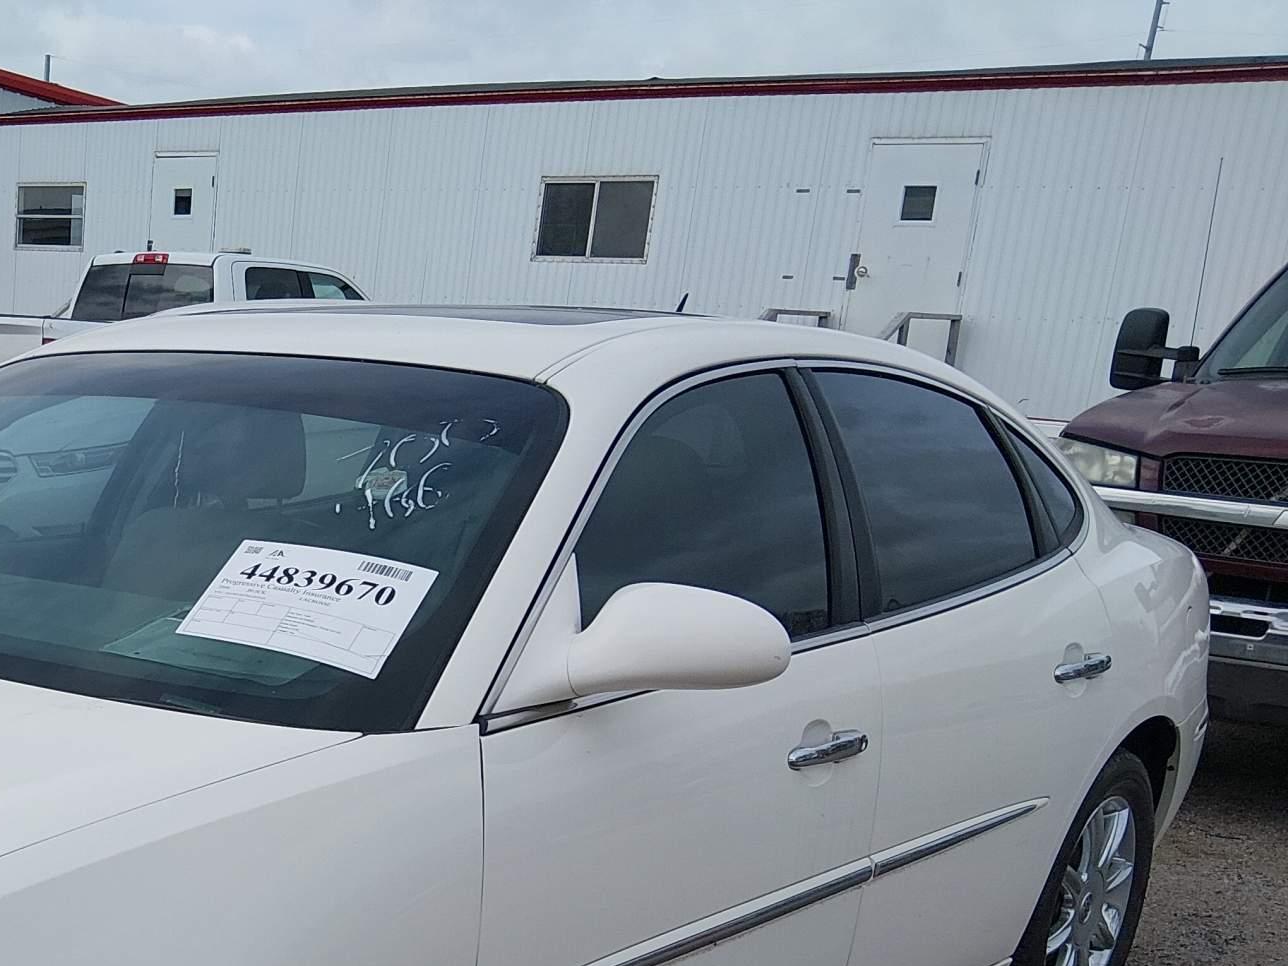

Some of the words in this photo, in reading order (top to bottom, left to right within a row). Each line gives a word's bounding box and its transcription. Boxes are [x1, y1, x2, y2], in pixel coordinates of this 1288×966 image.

[221, 577, 266, 589] Progressive
[266, 583, 301, 595] Casualty
[303, 589, 341, 602] Insurance
[239, 561, 397, 606] 44839670
